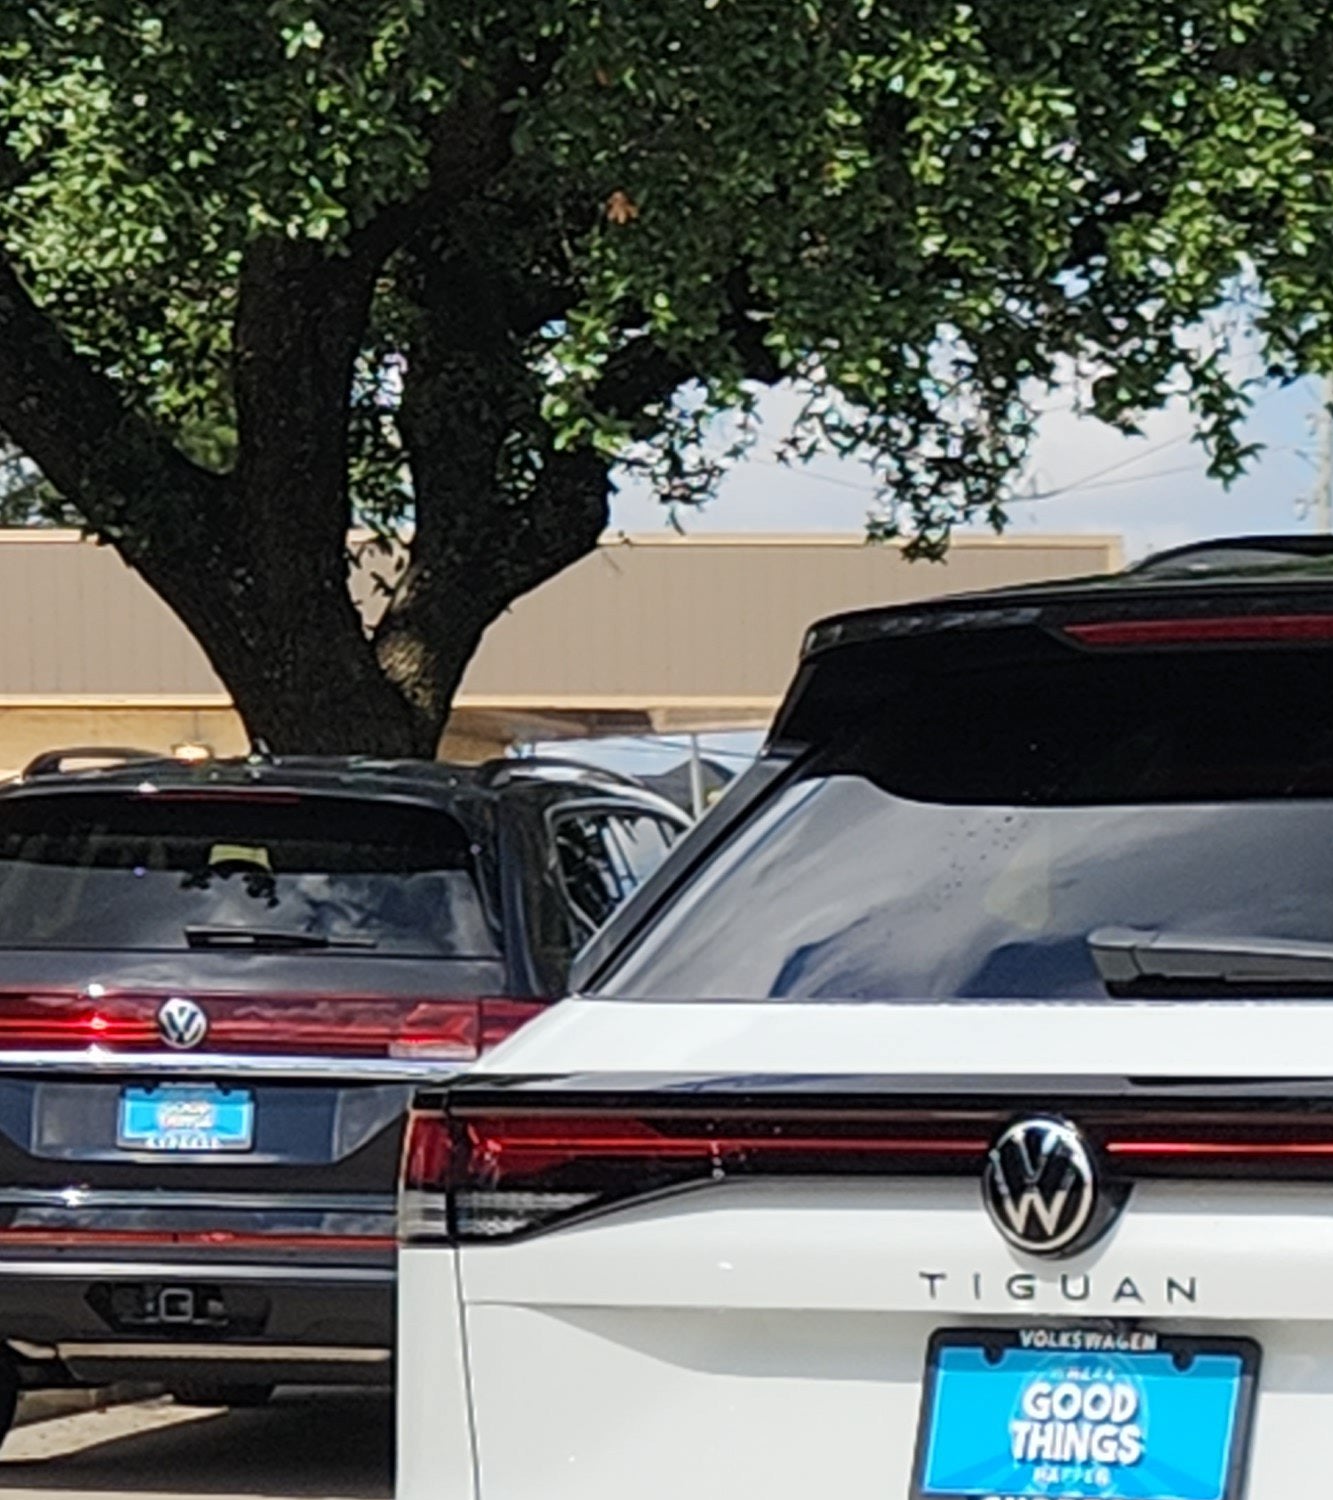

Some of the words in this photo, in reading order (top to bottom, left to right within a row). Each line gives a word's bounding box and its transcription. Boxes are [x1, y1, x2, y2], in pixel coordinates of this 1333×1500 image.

[158, 997, 207, 1049] VW
[986, 1118, 1093, 1250] VW
[919, 1271, 1197, 1303] TIGUAN
[1019, 1329, 1158, 1351] VOLKSWAGEN
[1021, 1381, 1138, 1423] GOOD
[1009, 1420, 1144, 1465] THINGS
